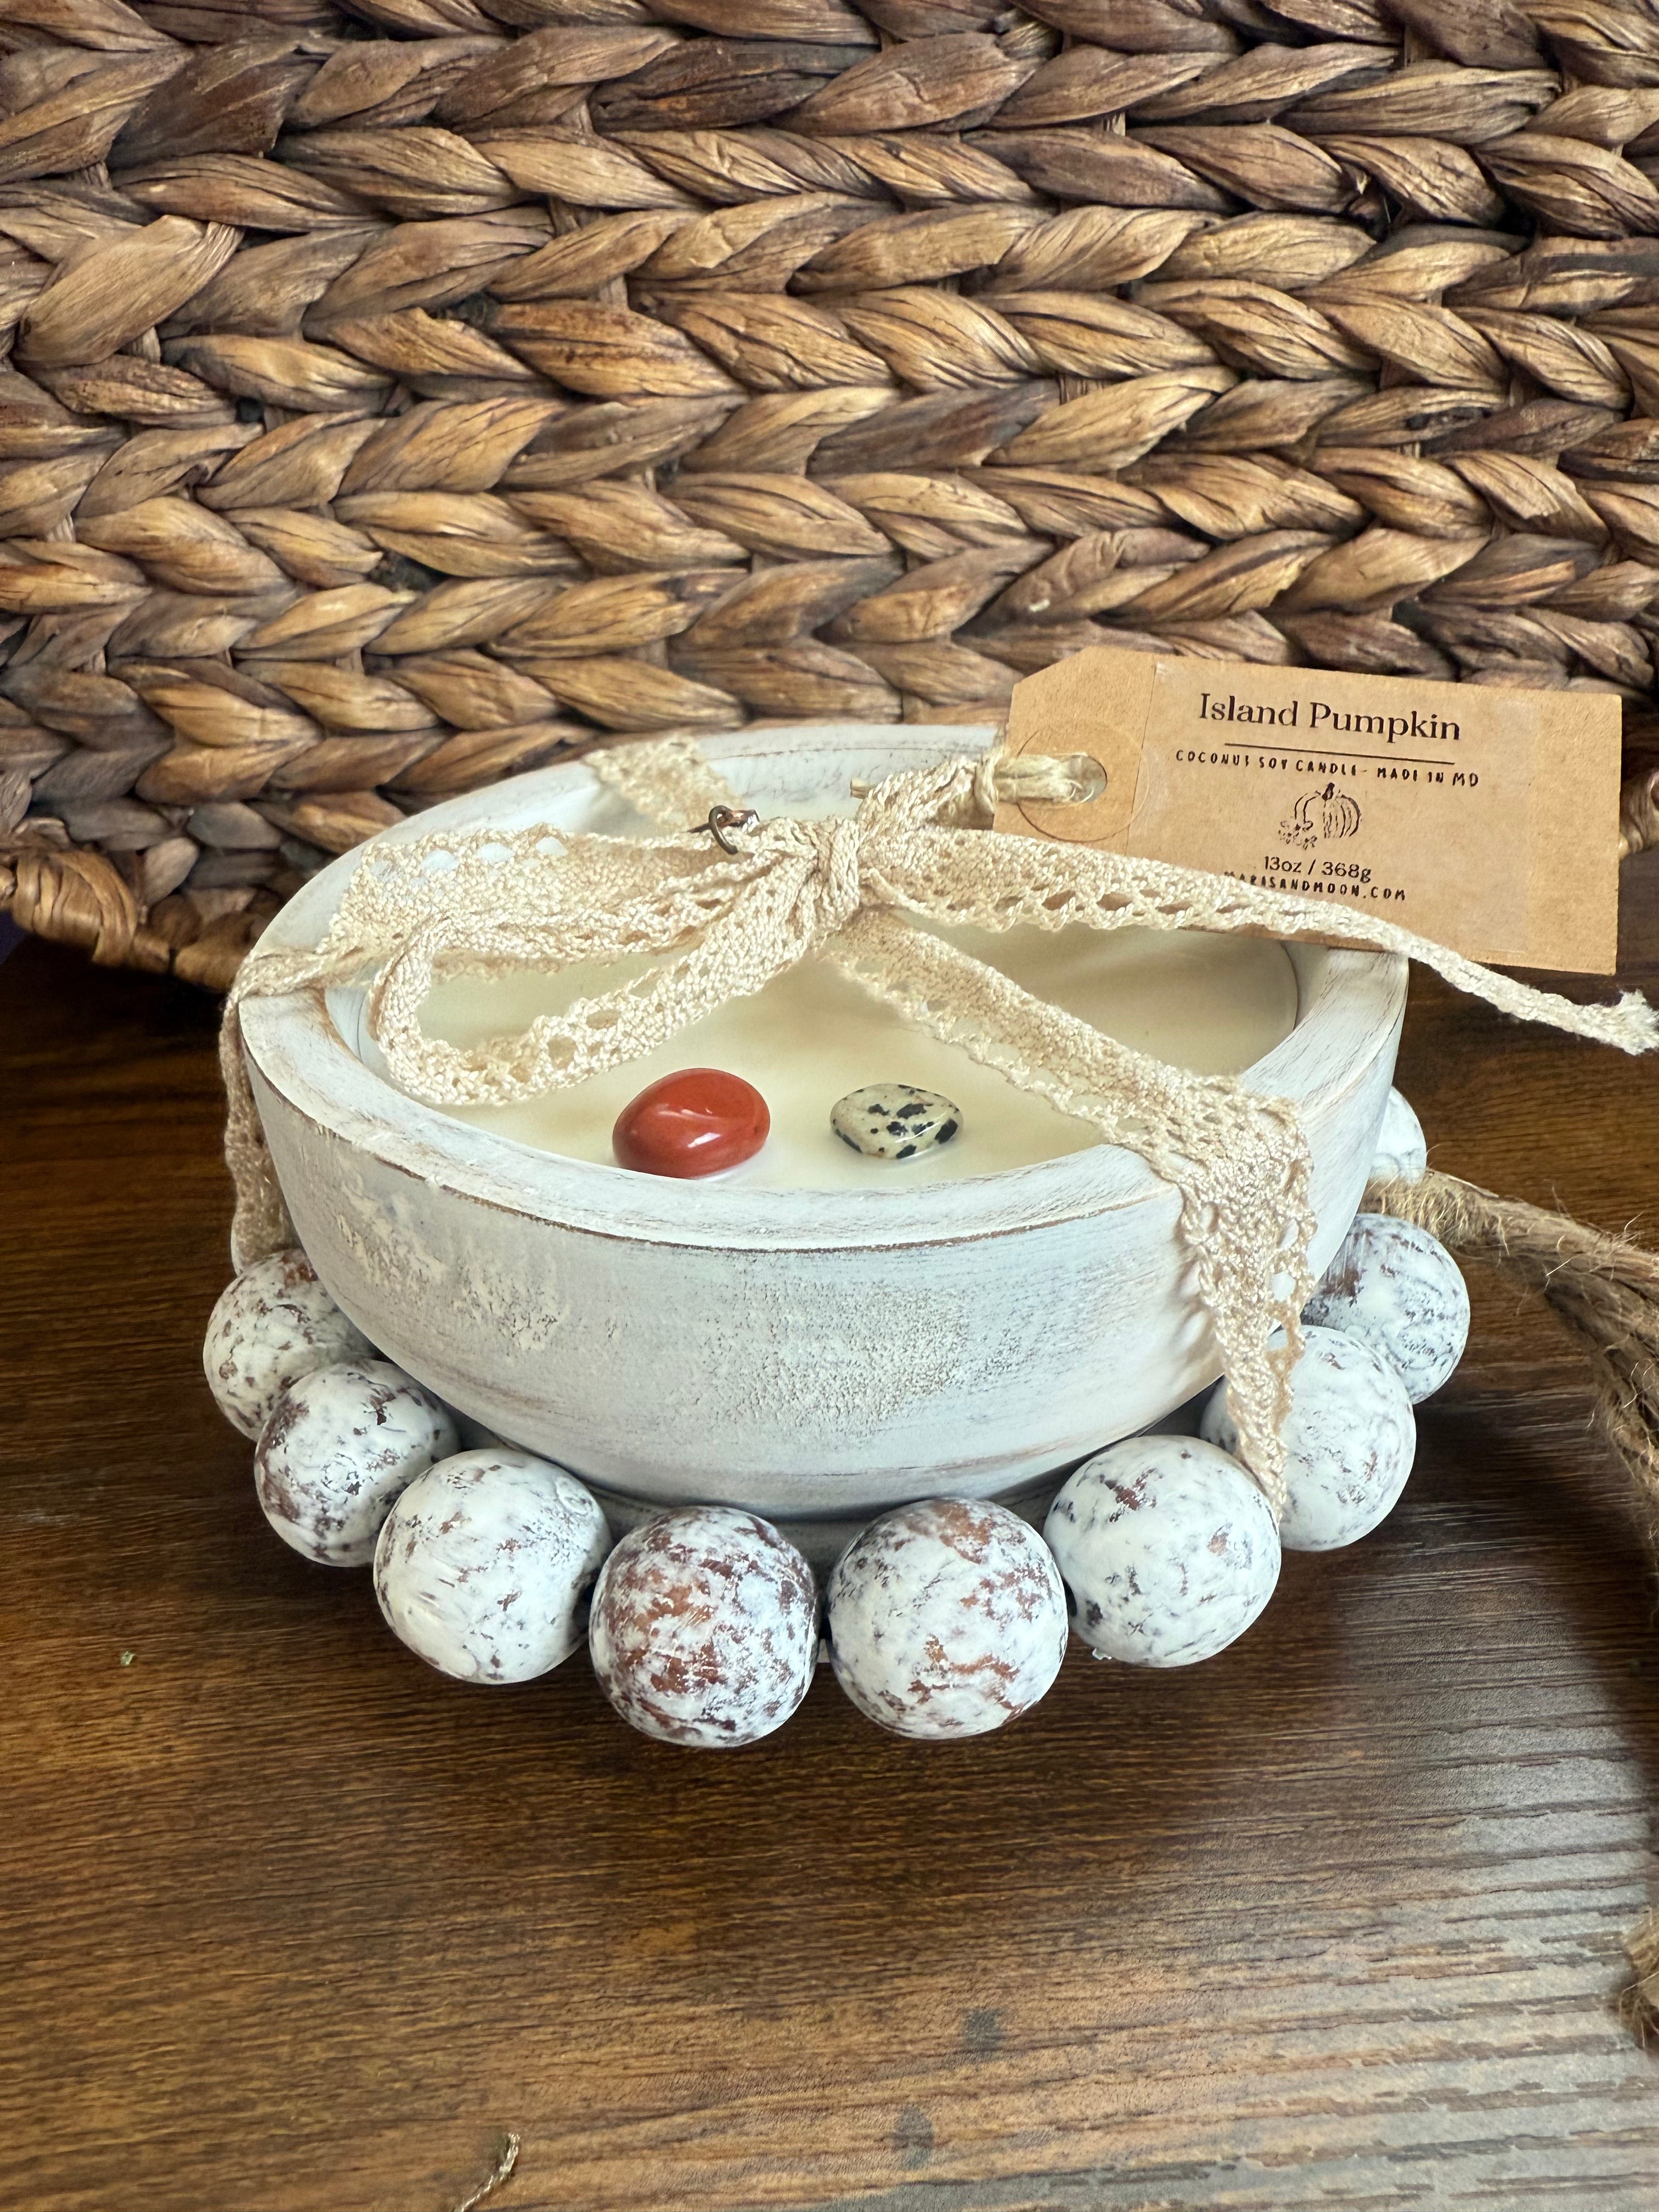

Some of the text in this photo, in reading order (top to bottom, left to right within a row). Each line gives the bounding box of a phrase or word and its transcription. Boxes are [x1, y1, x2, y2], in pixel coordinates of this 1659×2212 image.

[1199, 692, 1460, 743] Island Pumpkin
[1259, 756, 1288, 770] SOY
[1427, 771, 1444, 783] IN
[1452, 772, 1479, 787] MD
[1265, 855, 1372, 884] 13oz / 368g
